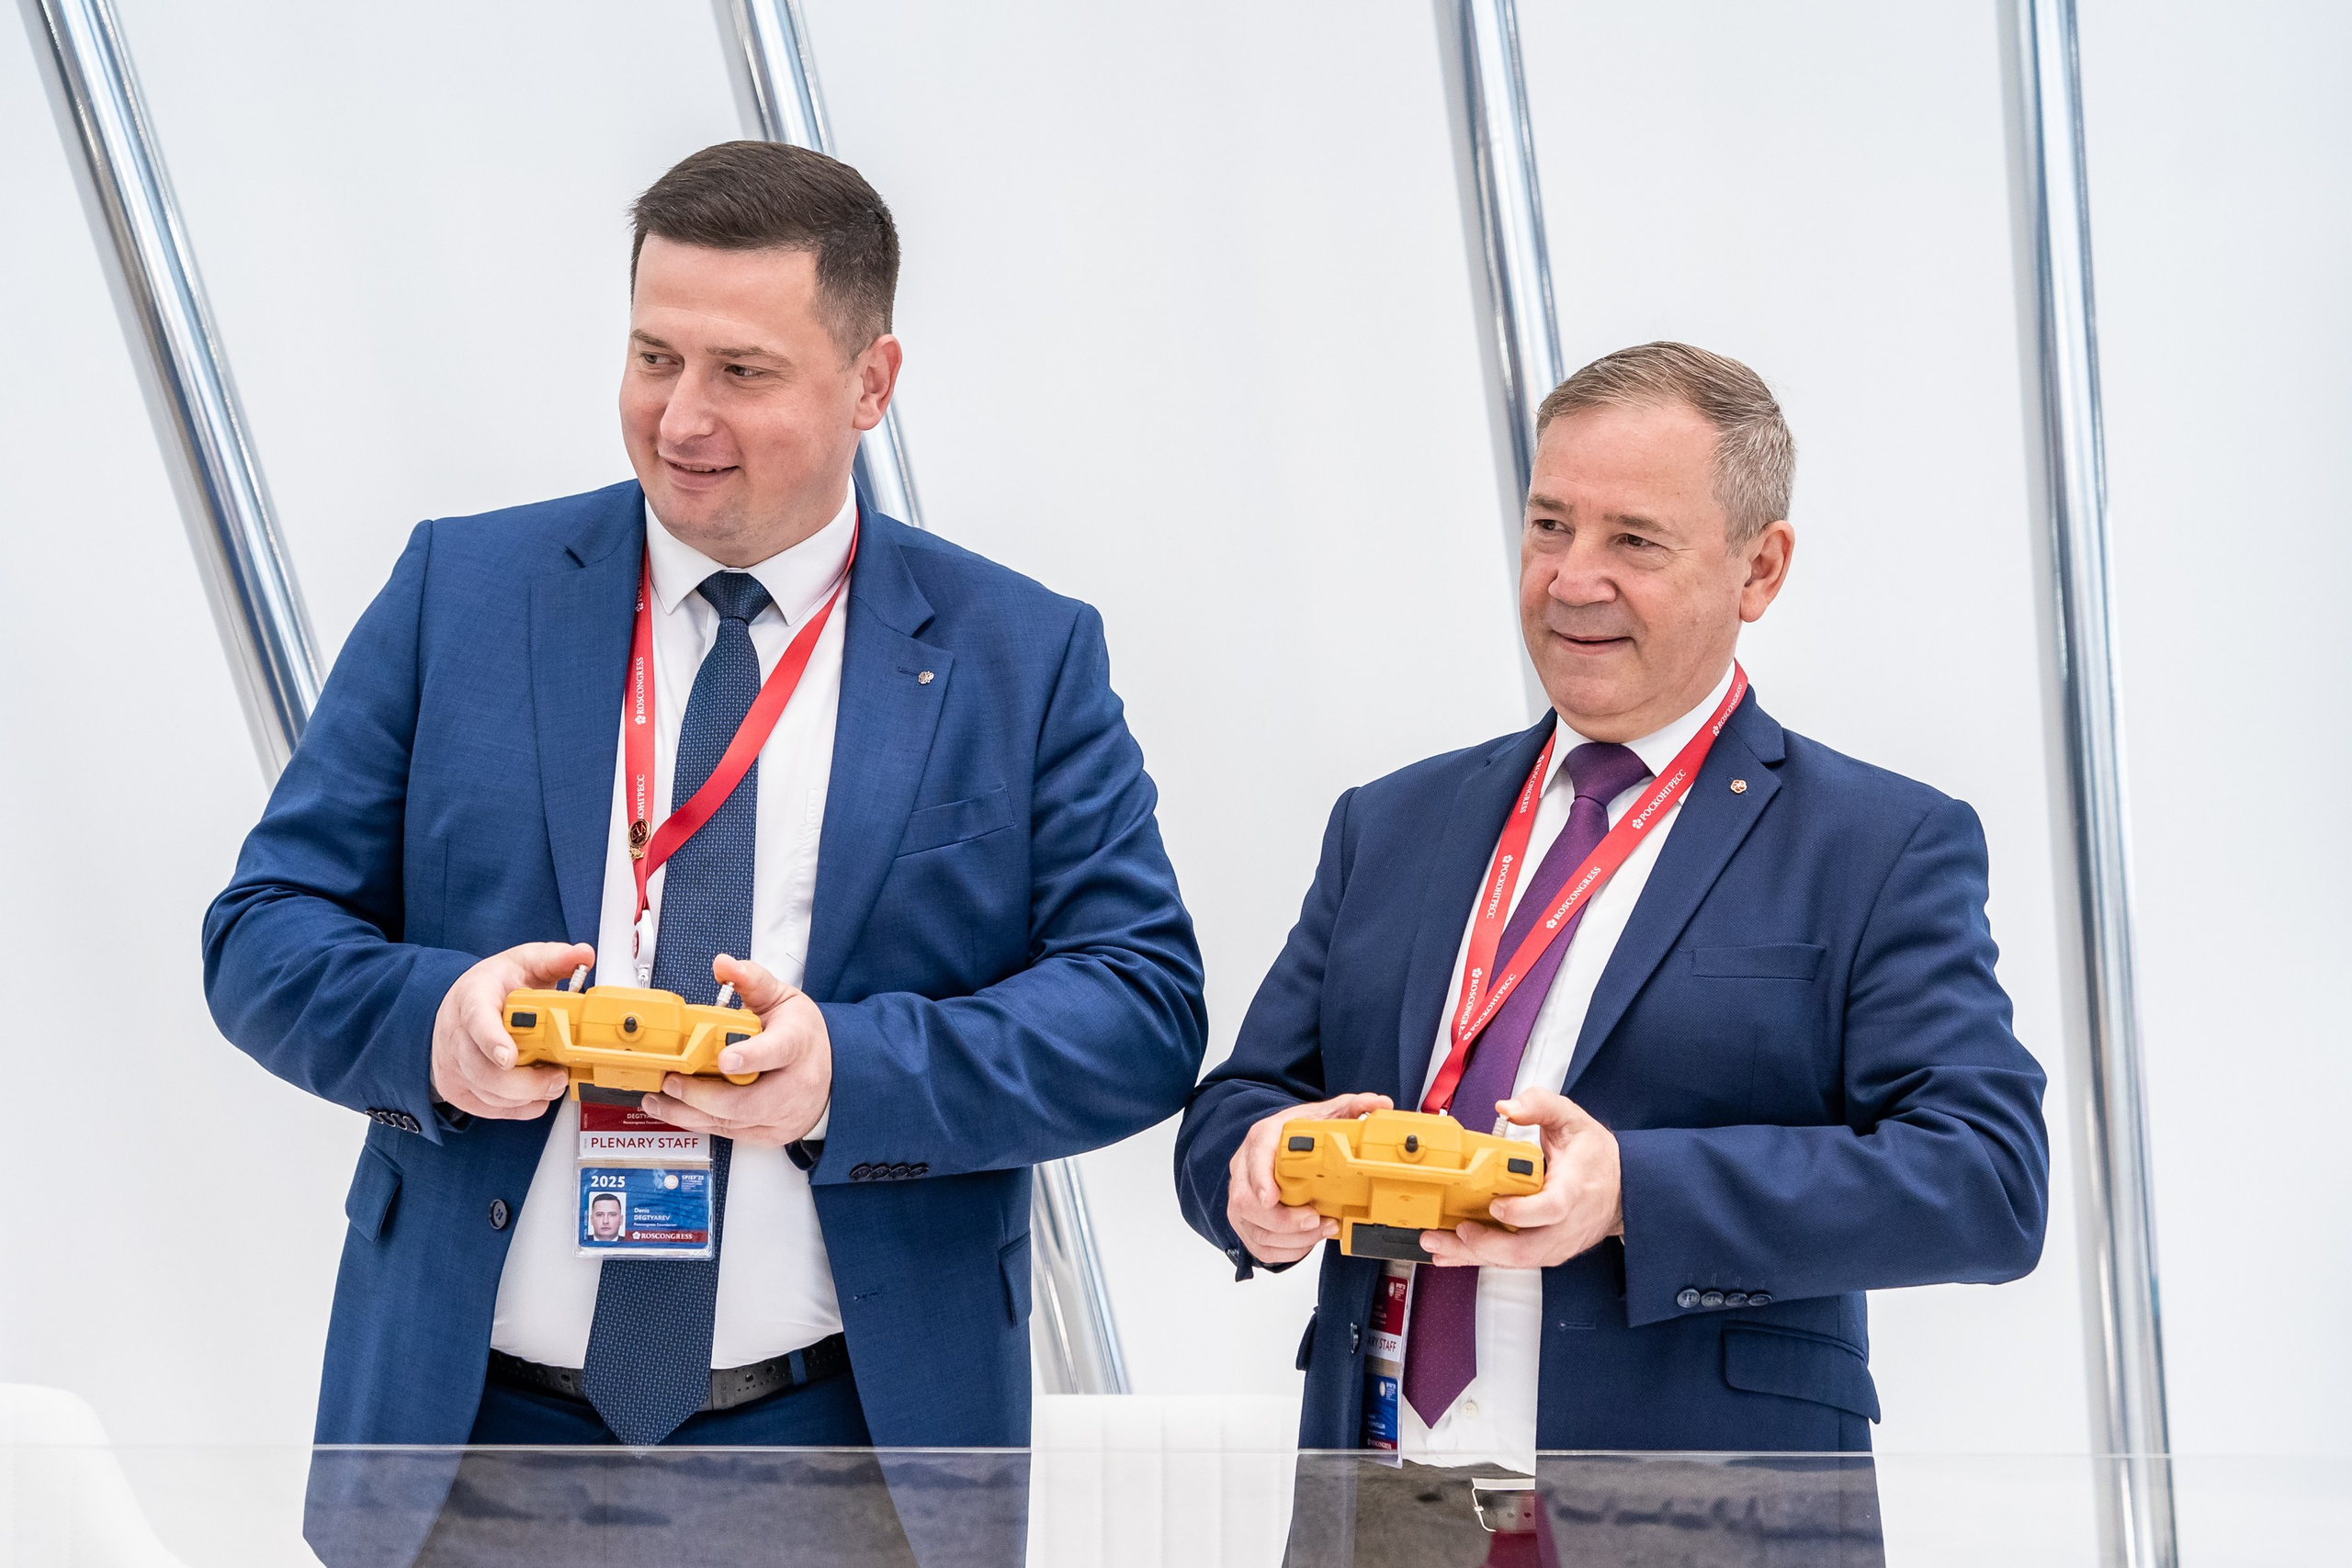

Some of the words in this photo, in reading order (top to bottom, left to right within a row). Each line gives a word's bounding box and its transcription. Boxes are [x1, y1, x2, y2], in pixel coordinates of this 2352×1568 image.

[636, 656, 645, 715] ROSCONGRESS
[637, 773, 645, 819] КОНГРЕСС
[1639, 769, 1687, 821] РОСКОНГРЕСС
[1487, 863, 1510, 919] РОСКОНГРЕСС
[1553, 865, 1601, 920] ROSCONGRESS
[1470, 974, 1517, 1032] РОСКОНГРЕСС
[591, 1137, 655, 1148] PLENARY
[658, 1137, 698, 1148] STAFF
[590, 1175, 626, 1188] 2025
[1379, 1338, 1396, 1352] STAFF
